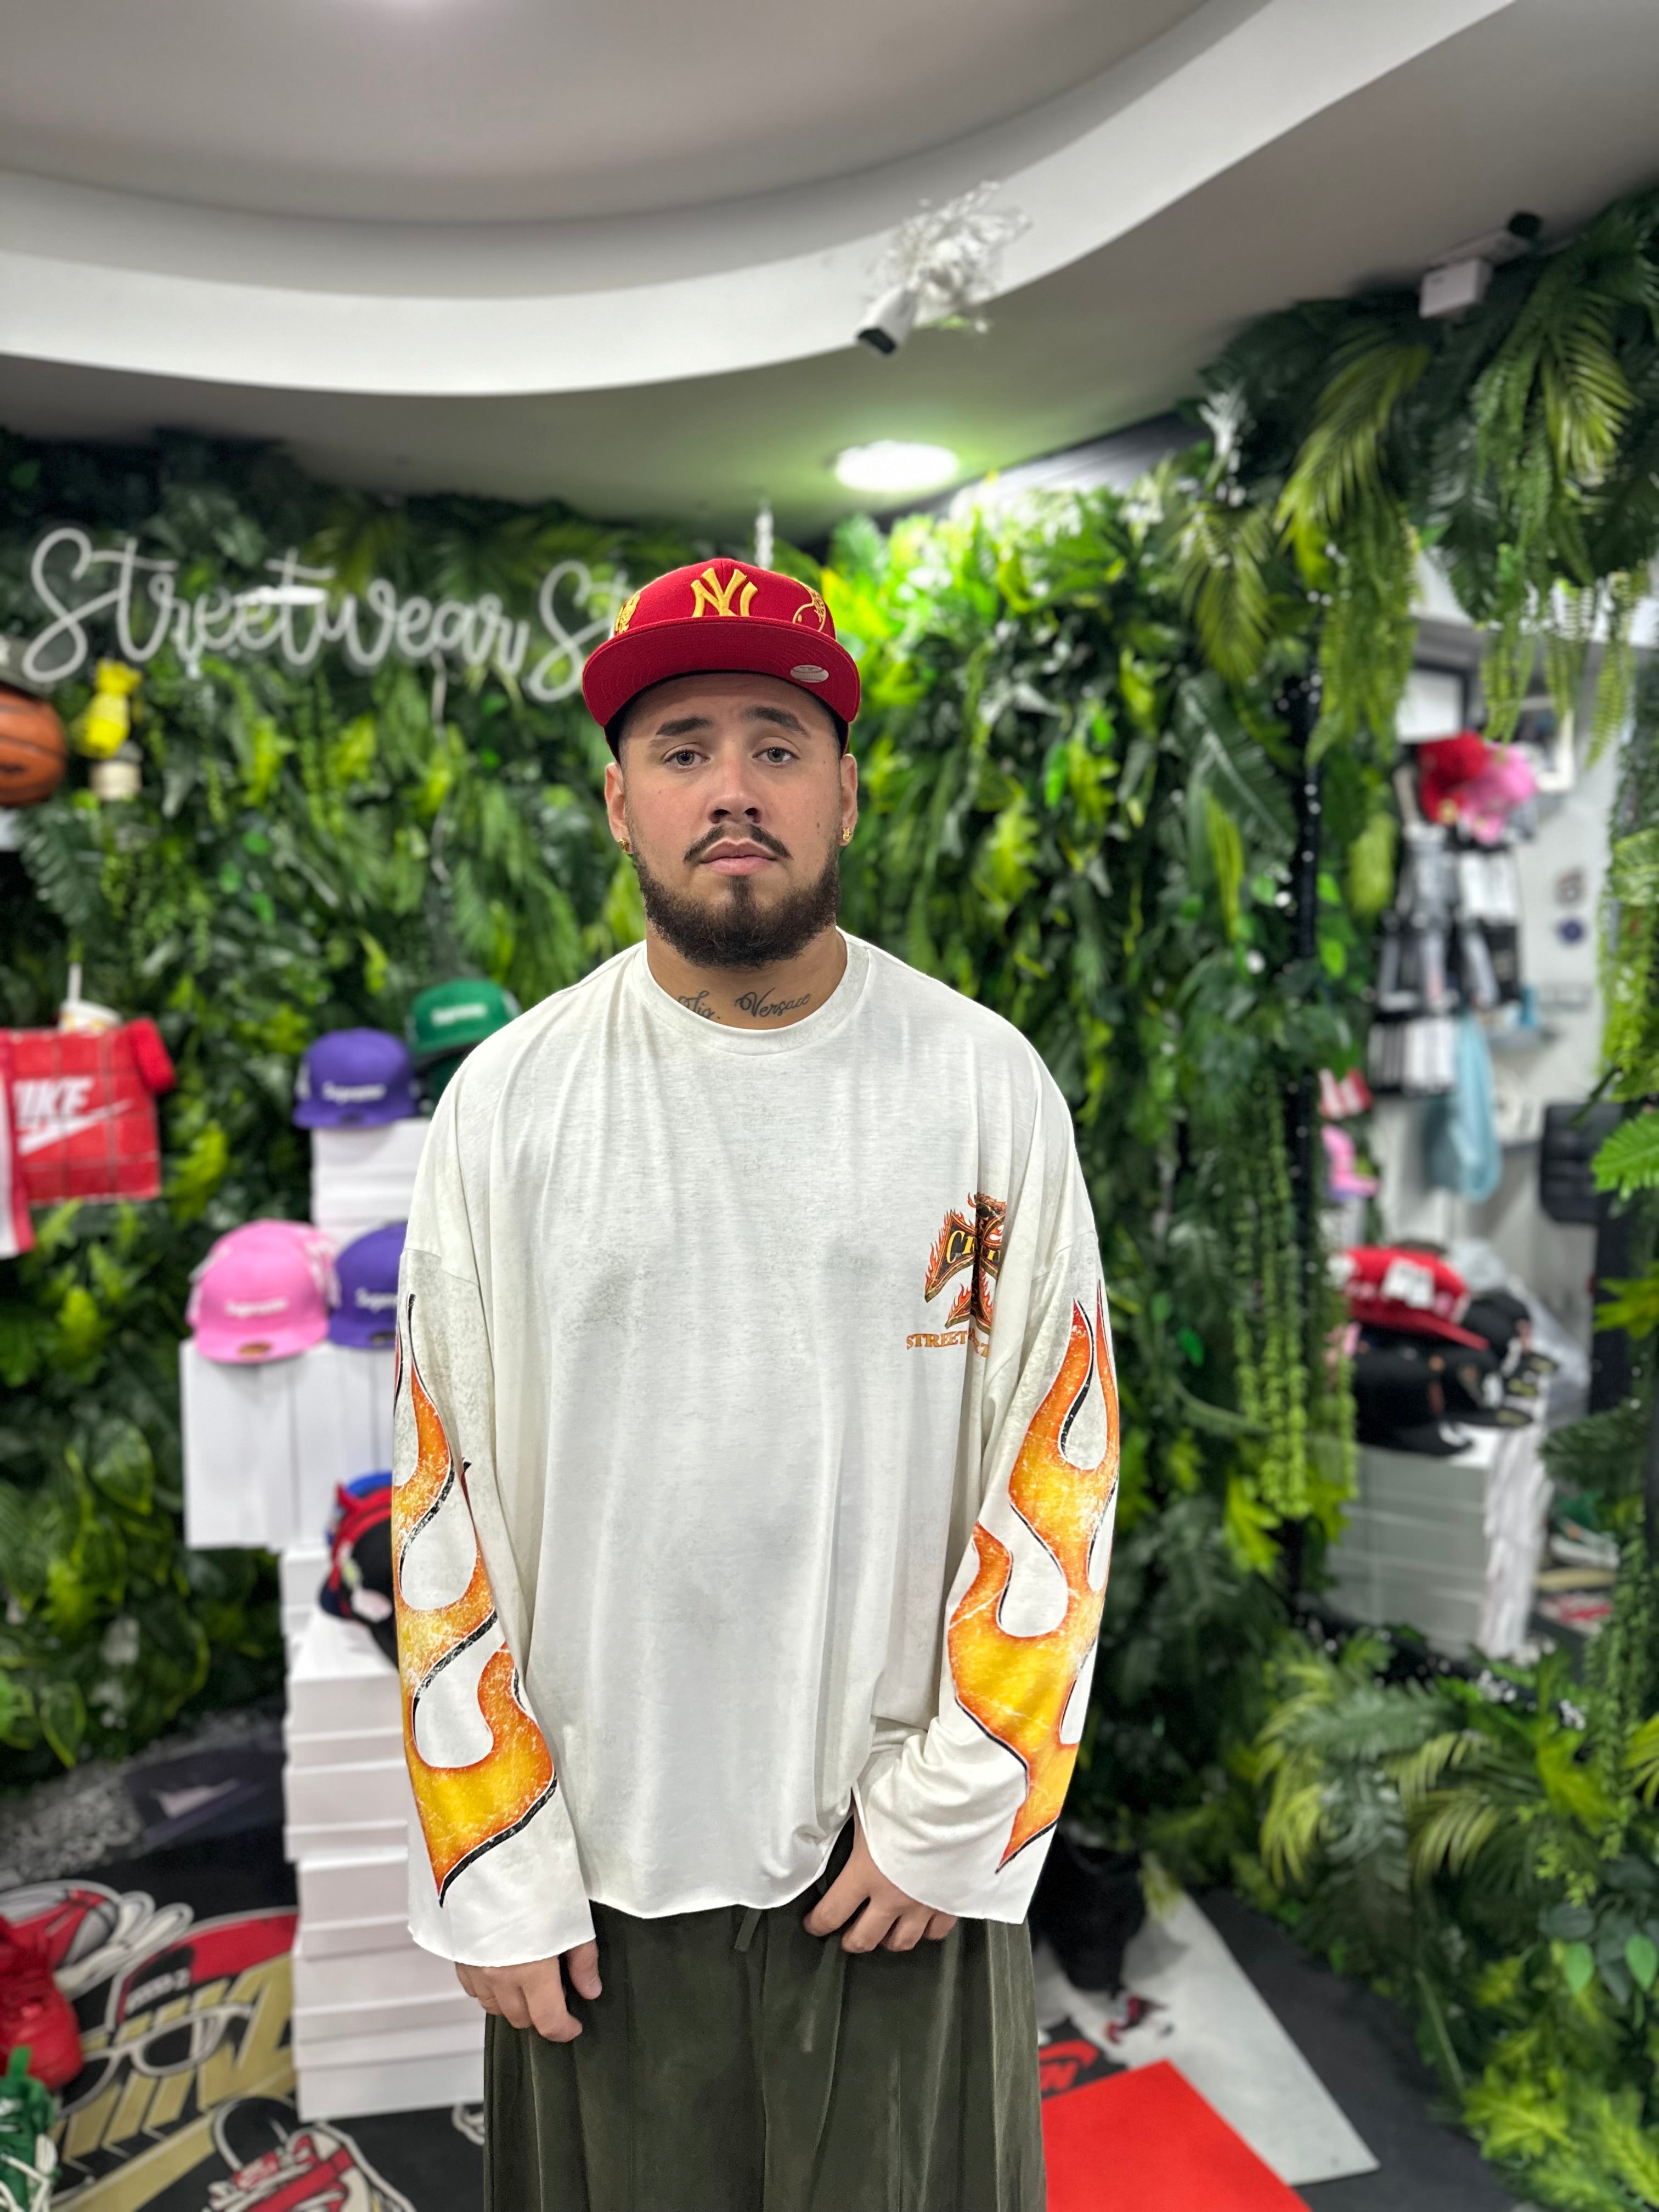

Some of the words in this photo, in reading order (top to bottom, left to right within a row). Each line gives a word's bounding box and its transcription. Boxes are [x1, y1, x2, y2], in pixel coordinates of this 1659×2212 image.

[22, 527, 530, 683] Streetwear
[690, 567, 759, 618] NY
[735, 987, 812, 1018] Versace
[906, 1330, 969, 1350] STREET
